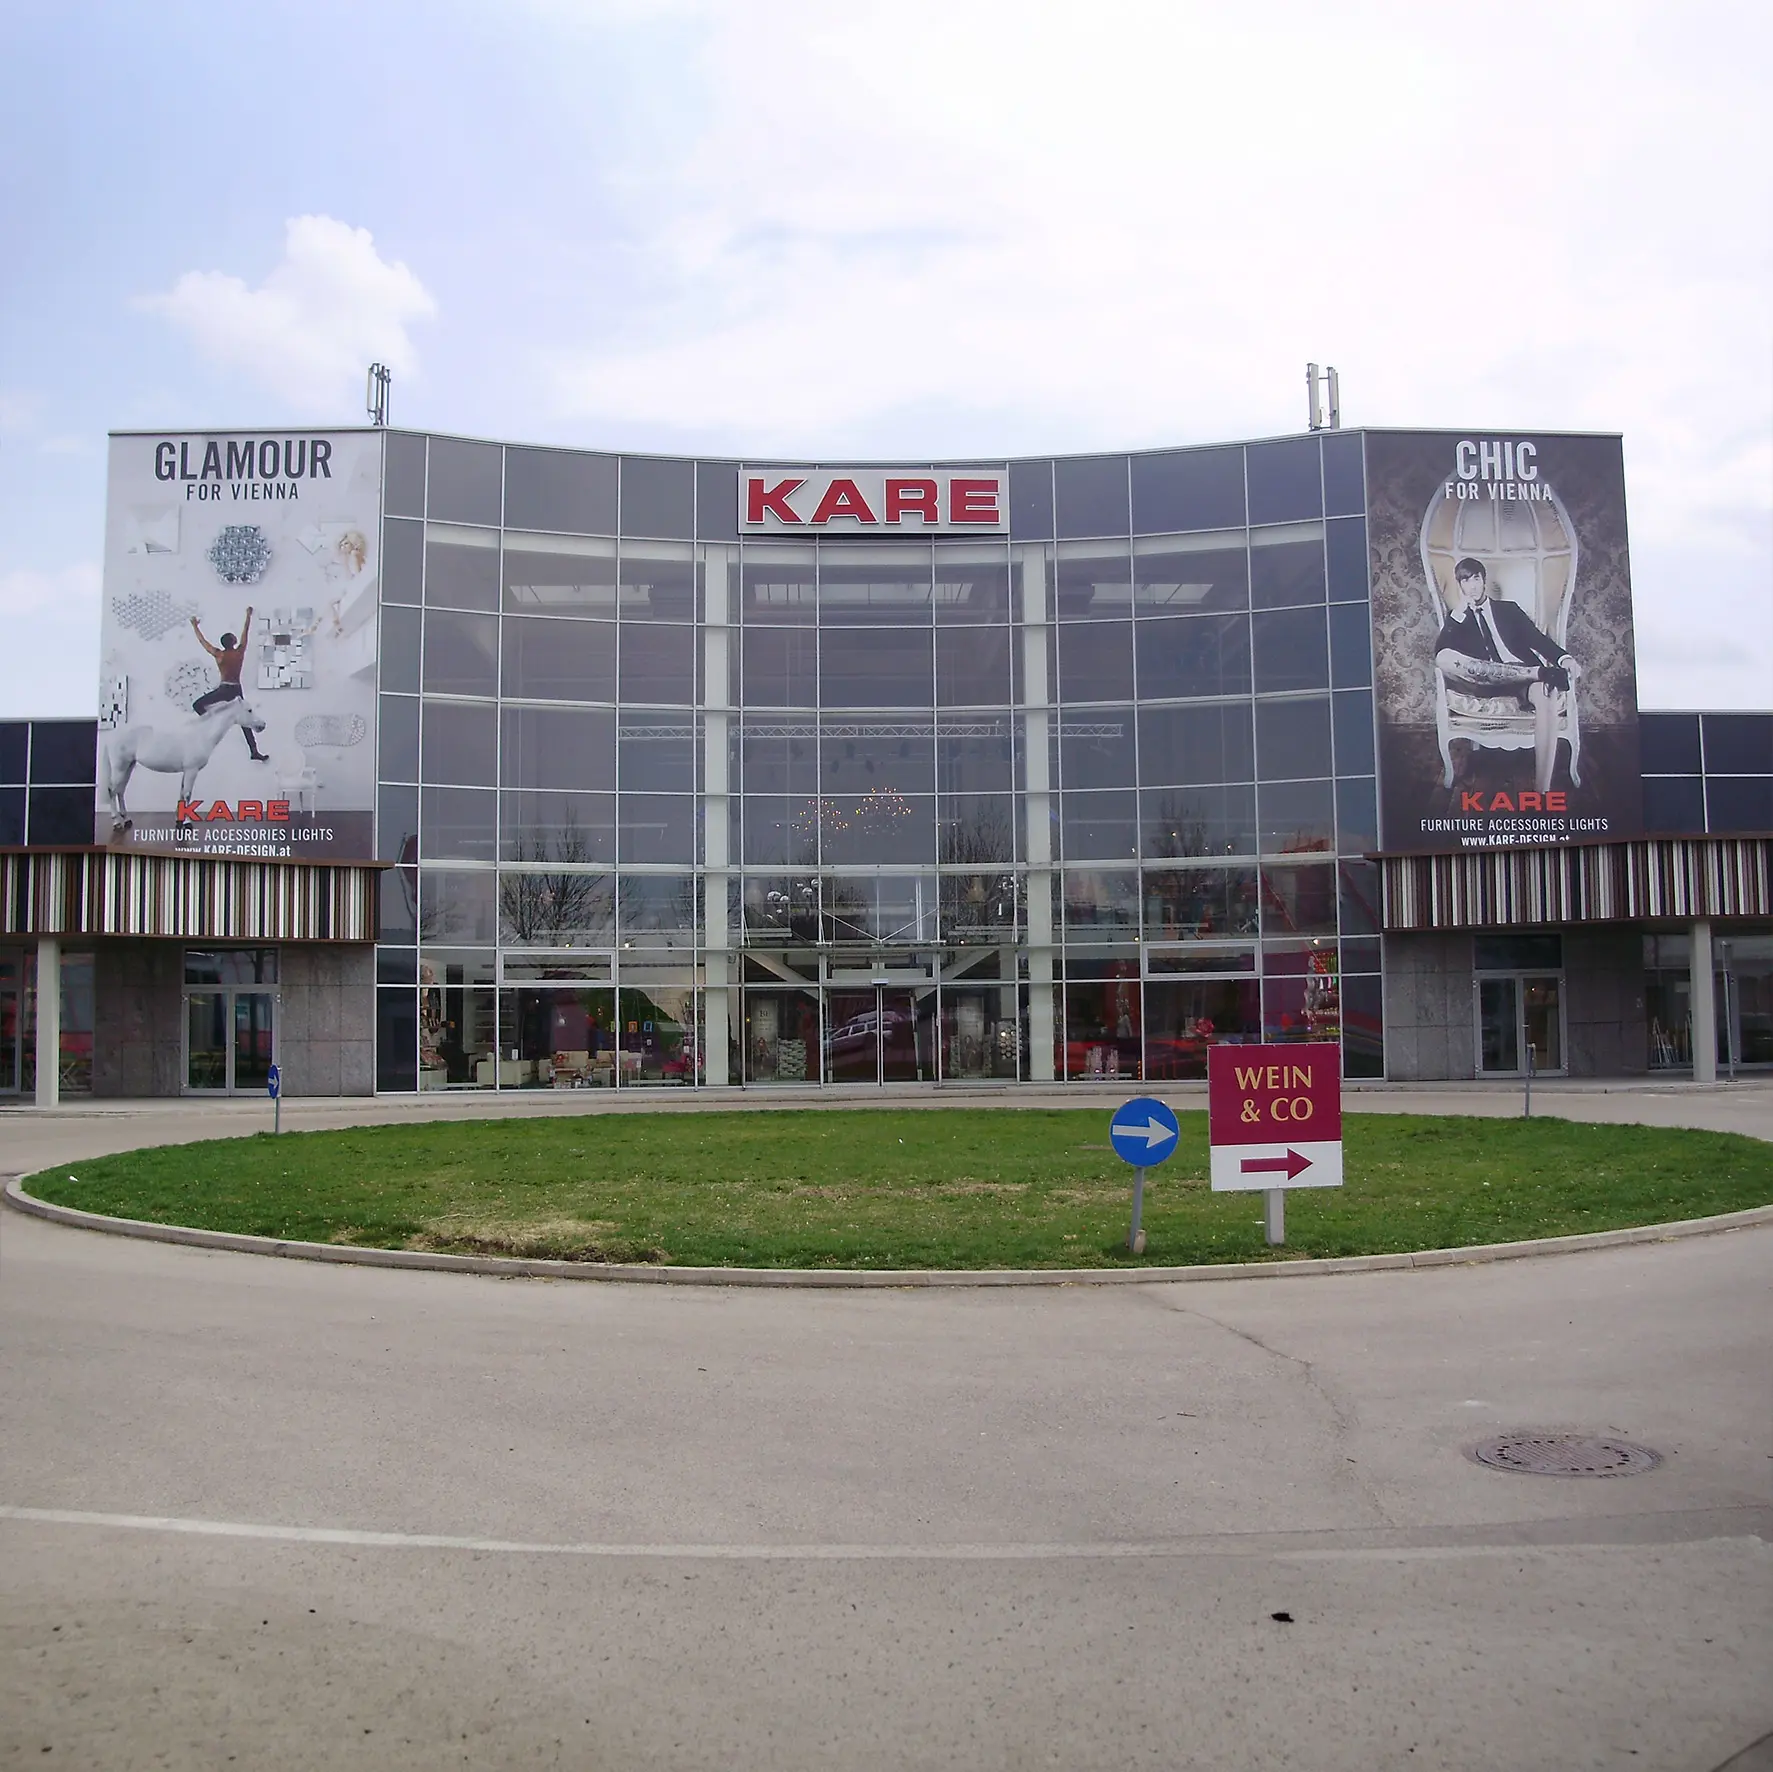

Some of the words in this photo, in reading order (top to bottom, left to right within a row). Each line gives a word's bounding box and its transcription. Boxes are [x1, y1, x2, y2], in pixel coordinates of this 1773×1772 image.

[154, 439, 332, 481] GLAMOUR
[1455, 440, 1538, 481] CHIC
[186, 483, 221, 501] FOR
[231, 482, 299, 500] VIENNA
[746, 478, 1001, 525] KARE
[1444, 482, 1480, 500] FOR
[1487, 482, 1553, 501] VIENNA
[176, 799, 290, 822] KARE
[1461, 791, 1568, 812] KARE
[133, 828, 199, 842] FURNITURE
[204, 828, 286, 841] ACCESSORIES
[291, 827, 334, 841] LIGHTS
[1420, 819, 1483, 831] FURNITURE
[1488, 818, 1565, 831] ACCESSORIES
[1569, 818, 1609, 831] LIGHTS
[174, 845, 291, 857] wwwKARE-DESIGN.at
[1460, 834, 1570, 847] www.KARE-DESIGNt
[1234, 1065, 1312, 1090] WEIN
[1240, 1099, 1260, 1123] &
[1270, 1096, 1314, 1121] CO
